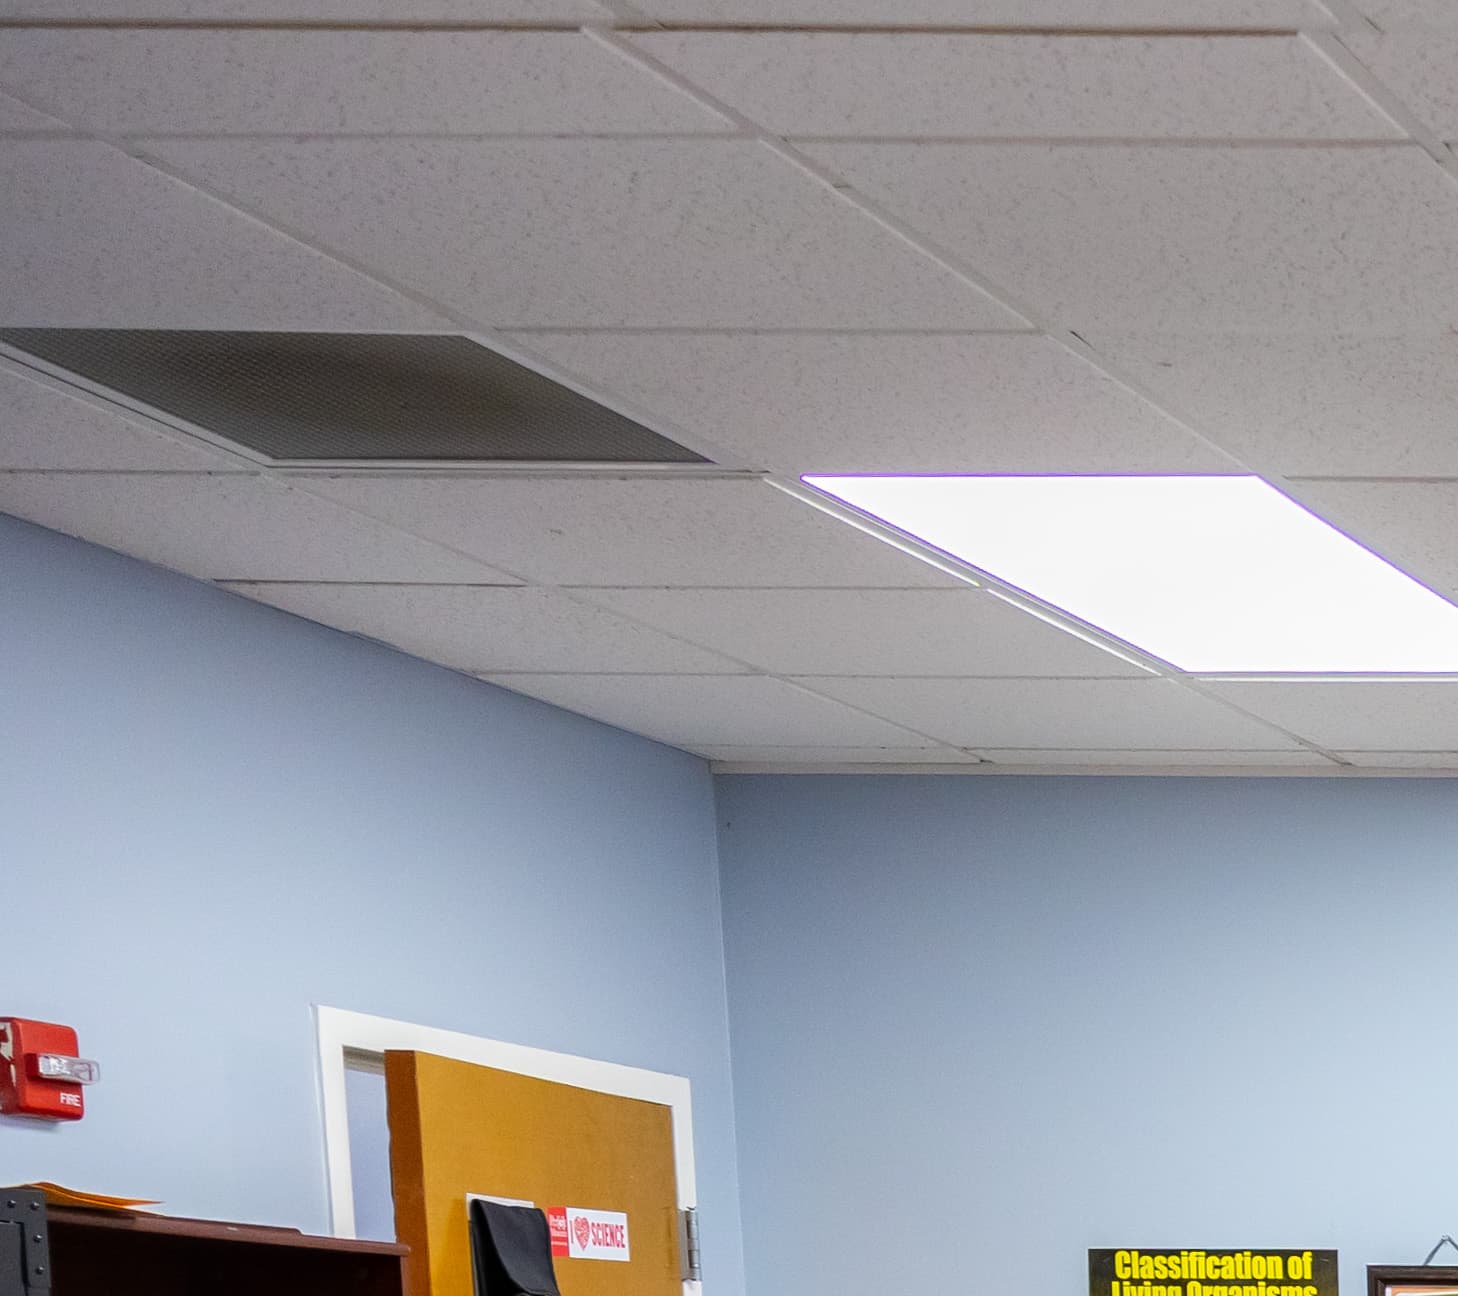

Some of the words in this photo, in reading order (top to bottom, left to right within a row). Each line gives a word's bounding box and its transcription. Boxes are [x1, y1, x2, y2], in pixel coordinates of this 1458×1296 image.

[60, 1093, 81, 1107] FIRE
[591, 1222, 625, 1248] SCIENCE
[1114, 1250, 1283, 1280] Classification
[1287, 1251, 1313, 1280] of
